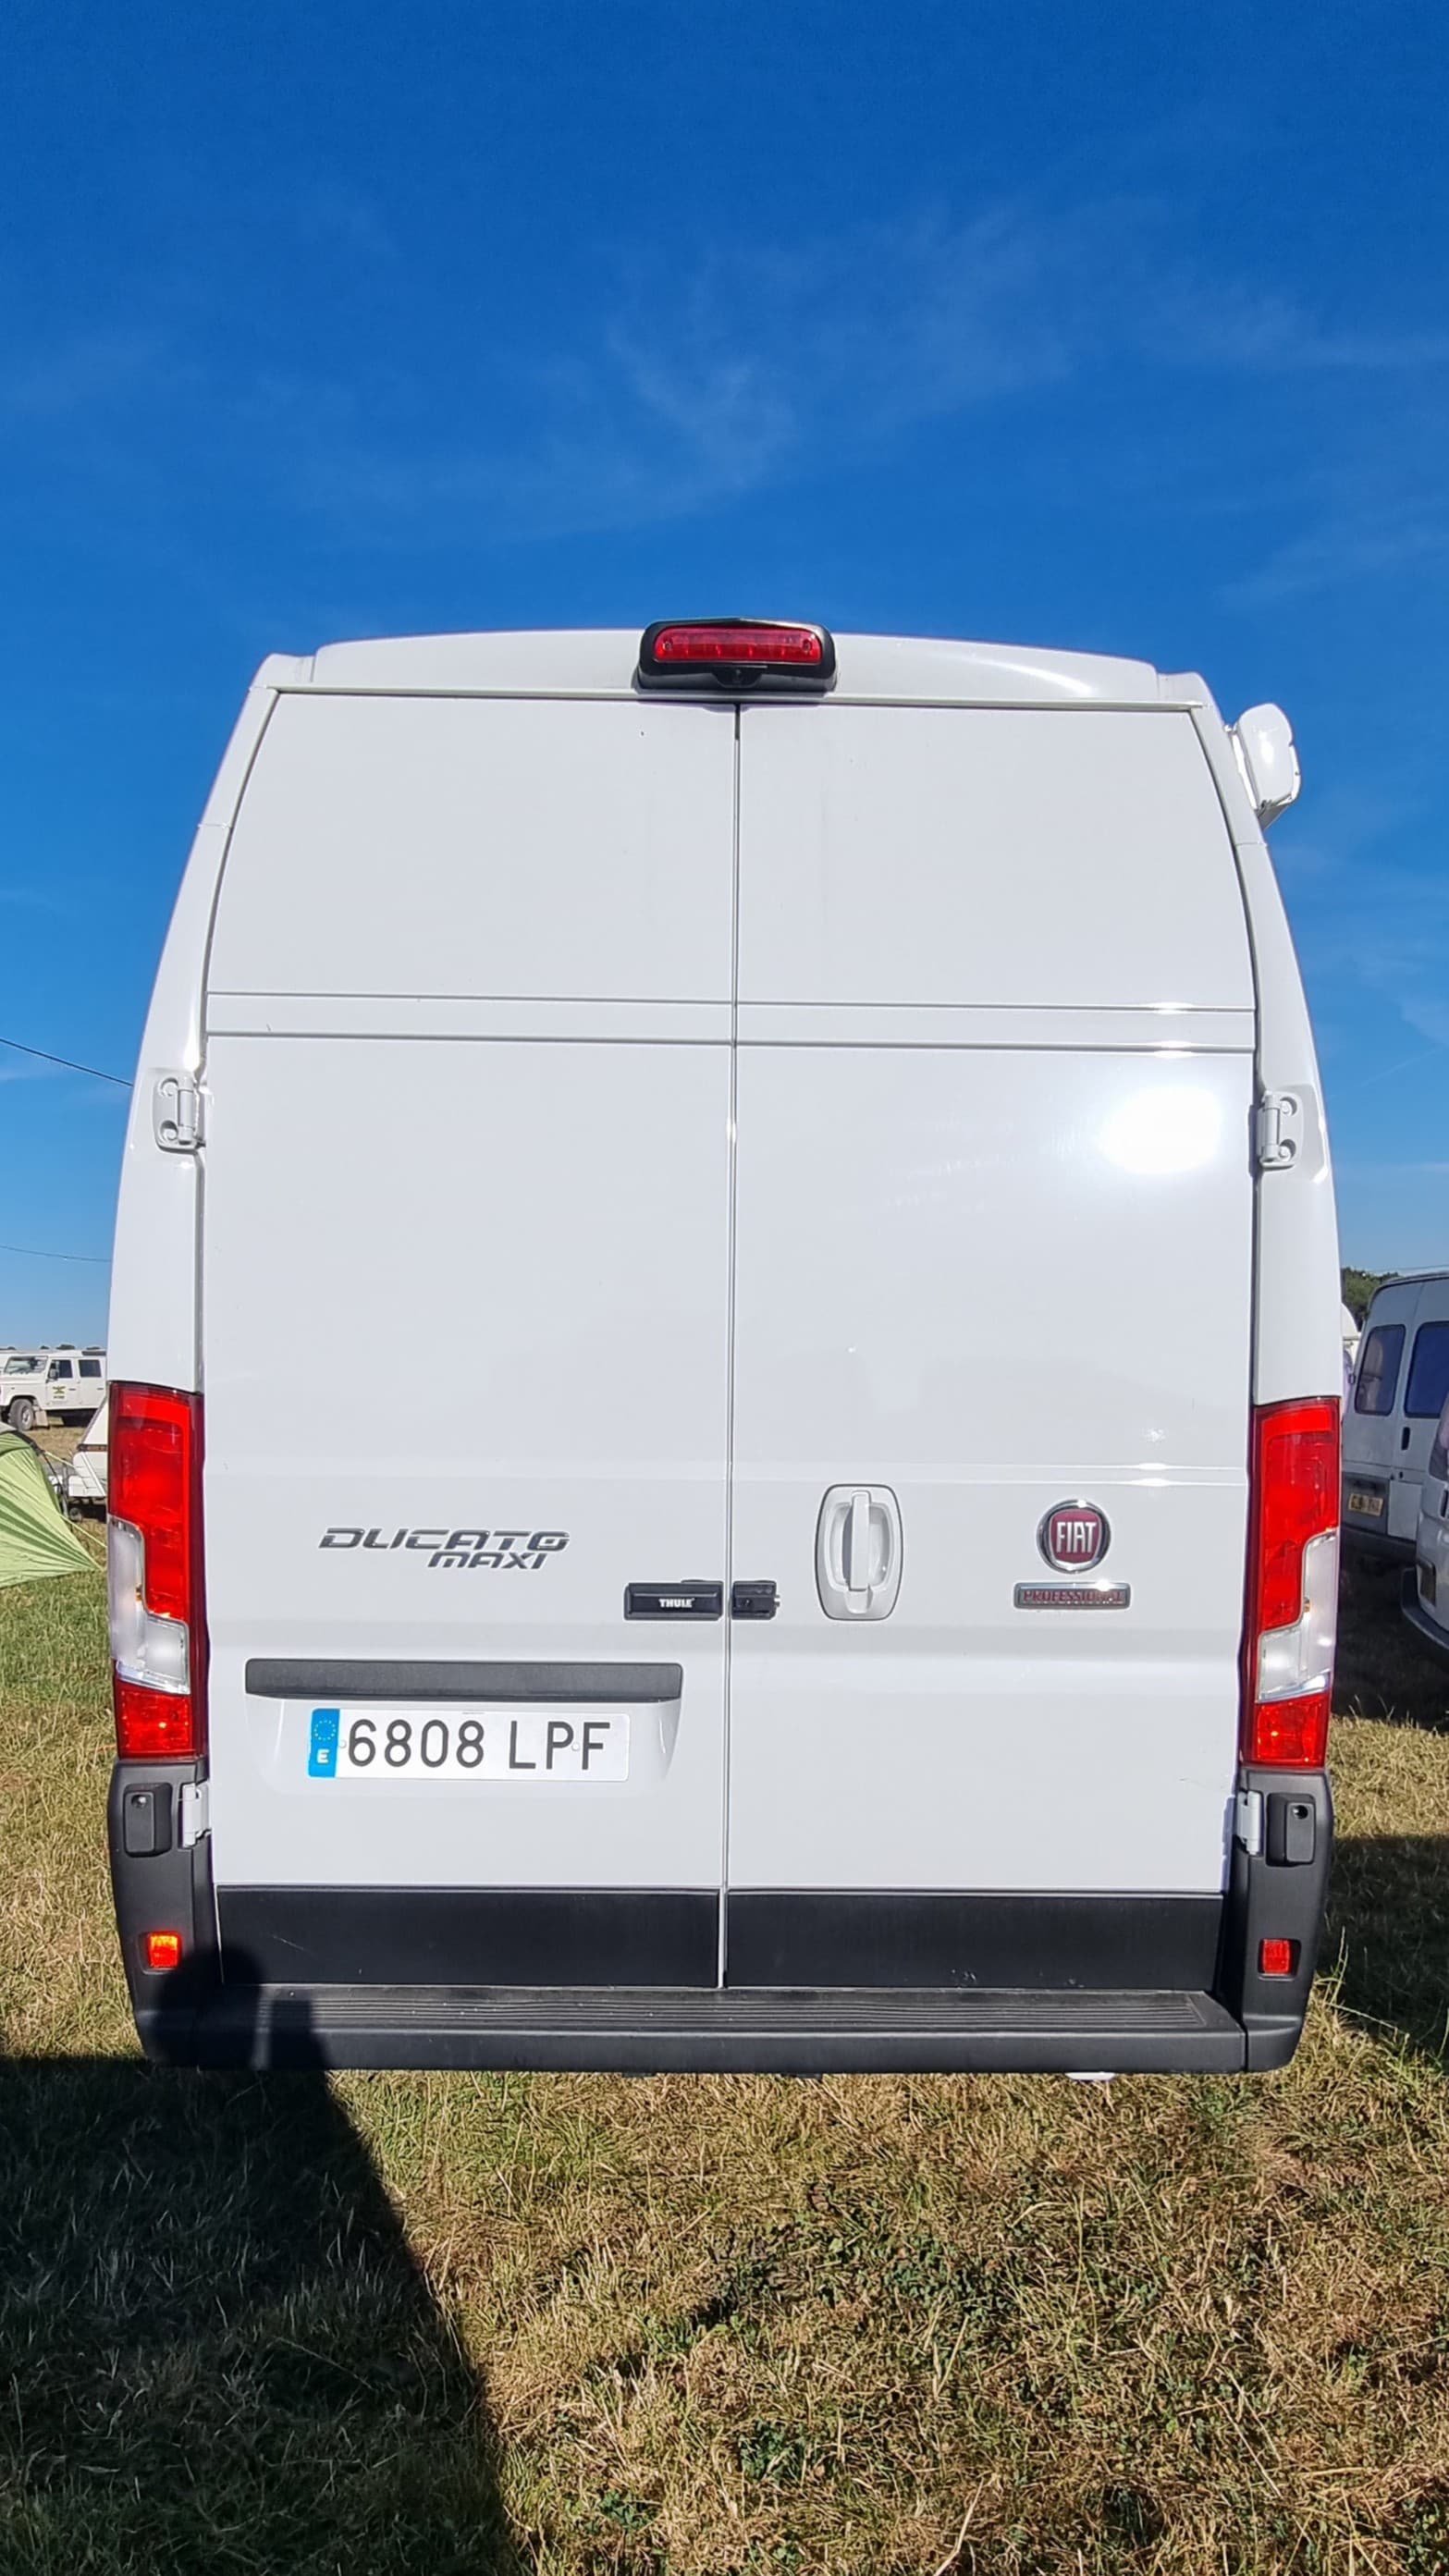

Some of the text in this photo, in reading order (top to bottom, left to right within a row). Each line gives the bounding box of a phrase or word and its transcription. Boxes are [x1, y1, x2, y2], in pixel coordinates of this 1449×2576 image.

[319, 1527, 570, 1551] DUCATO
[1056, 1521, 1097, 1552] FIAT
[427, 1552, 547, 1570] MAXI
[658, 1598, 694, 1608] THULE
[317, 1719, 610, 1770] E 6808 LPF
